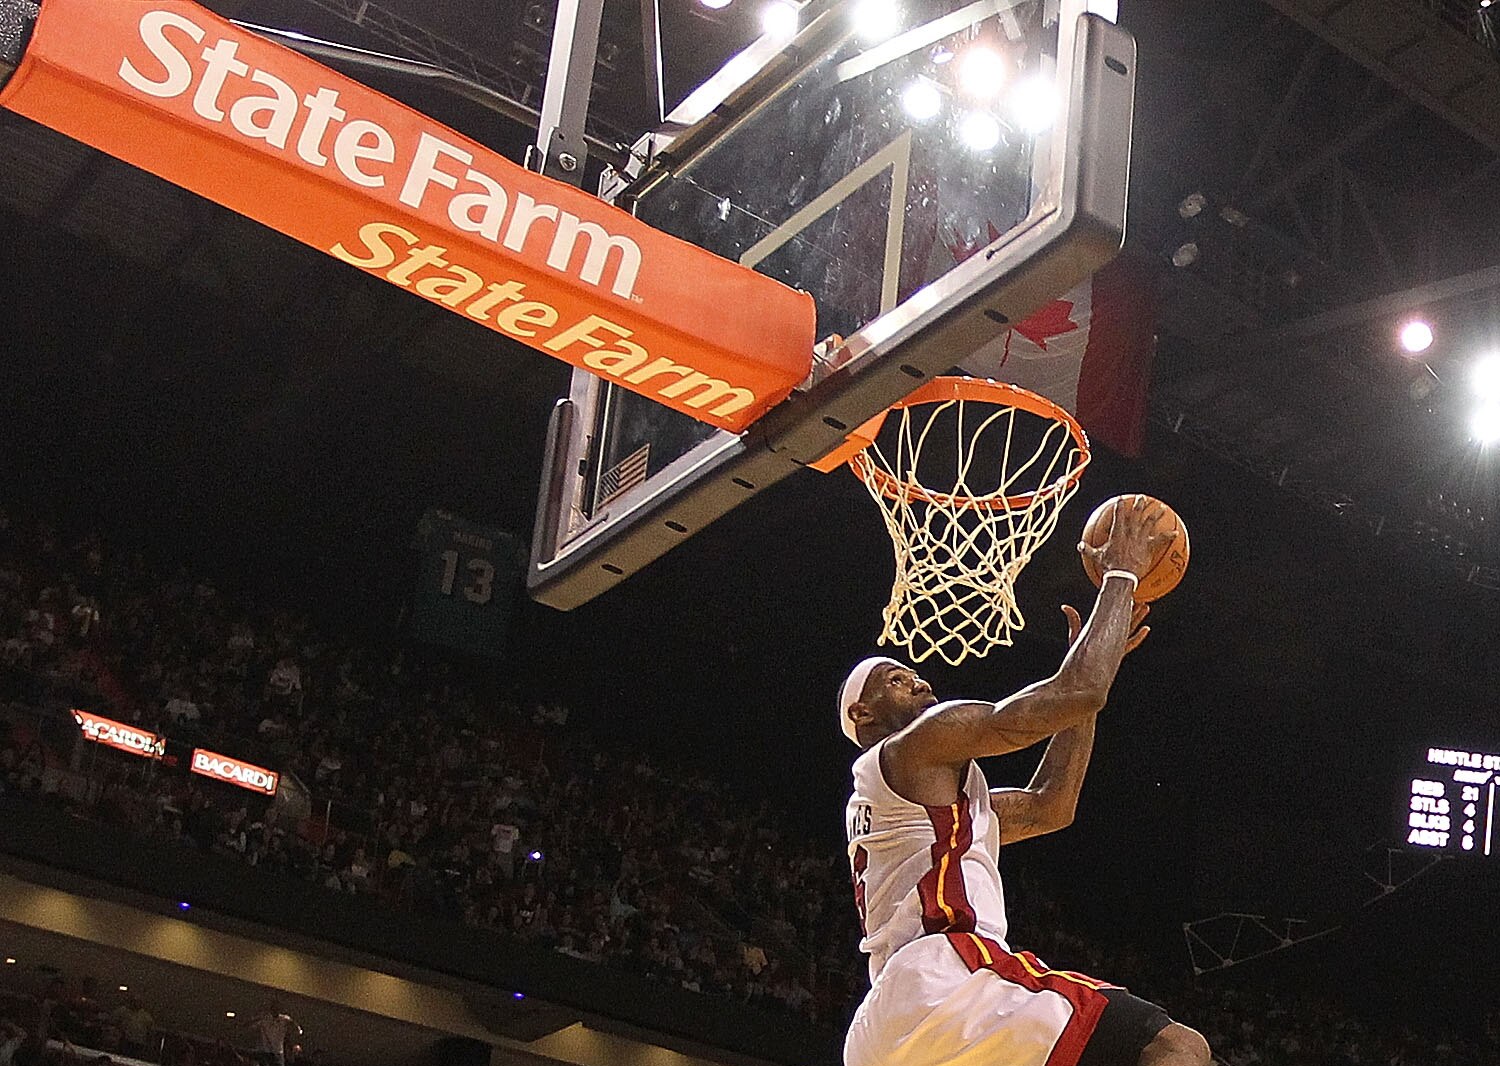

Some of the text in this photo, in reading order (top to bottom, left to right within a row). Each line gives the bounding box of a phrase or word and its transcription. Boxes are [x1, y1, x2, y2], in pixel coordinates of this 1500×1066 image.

[118, 10, 395, 187] State
[399, 131, 643, 299] Farm
[330, 222, 756, 418] State Farm
[440, 550, 496, 604] 13
[195, 753, 274, 791] BACARDI
[1427, 748, 1482, 769] HUSTLE
[1410, 795, 1450, 814] STLS
[1461, 785, 1479, 801] 21
